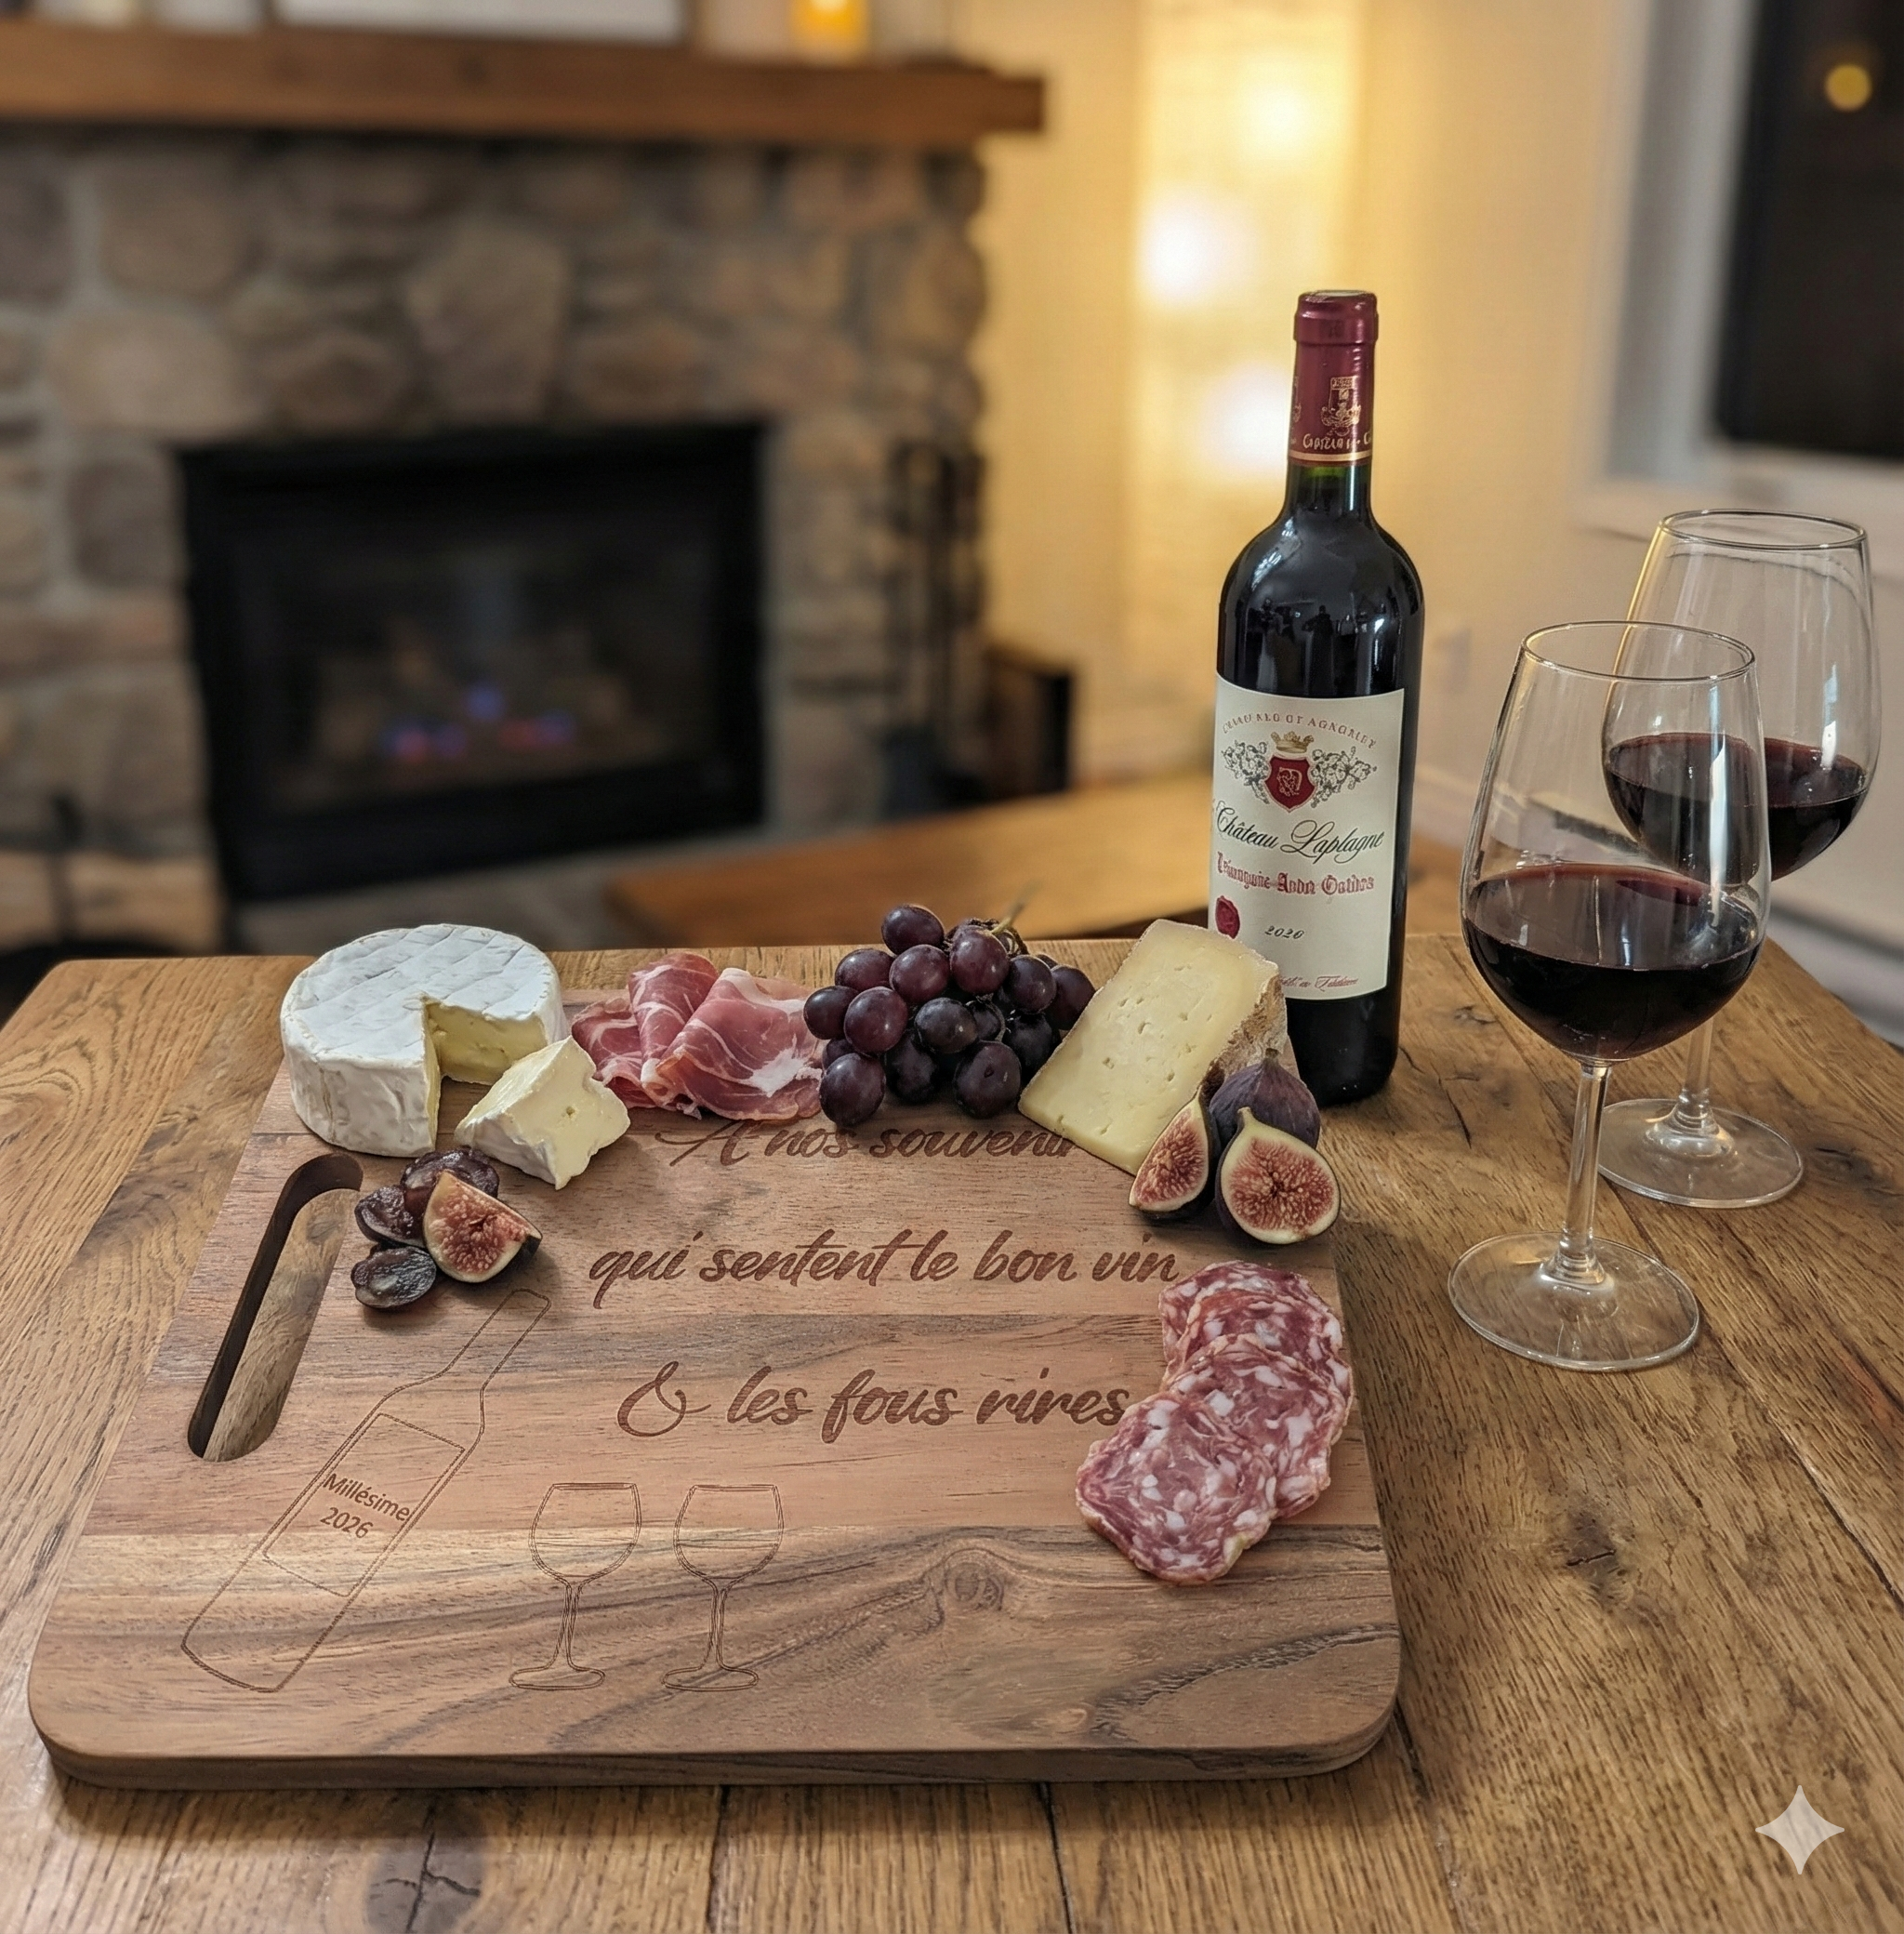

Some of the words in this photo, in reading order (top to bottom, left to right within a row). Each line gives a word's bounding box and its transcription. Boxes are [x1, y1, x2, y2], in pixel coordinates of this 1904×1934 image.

[1216, 807, 1279, 849] Château
[1280, 819, 1385, 865] Laplagne
[763, 1127, 860, 1159] nos
[588, 1230, 705, 1310] qui
[698, 1227, 925, 1288] sentent
[909, 1228, 959, 1282] le
[972, 1228, 1078, 1284] bon
[1091, 1231, 1180, 1283] vin
[616, 1360, 712, 1438] &
[725, 1365, 814, 1425] les
[820, 1368, 959, 1444] fous
[975, 1367, 1130, 1426] rires
[319, 1506, 375, 1539] 2026
[322, 1473, 411, 1522] Millésime
